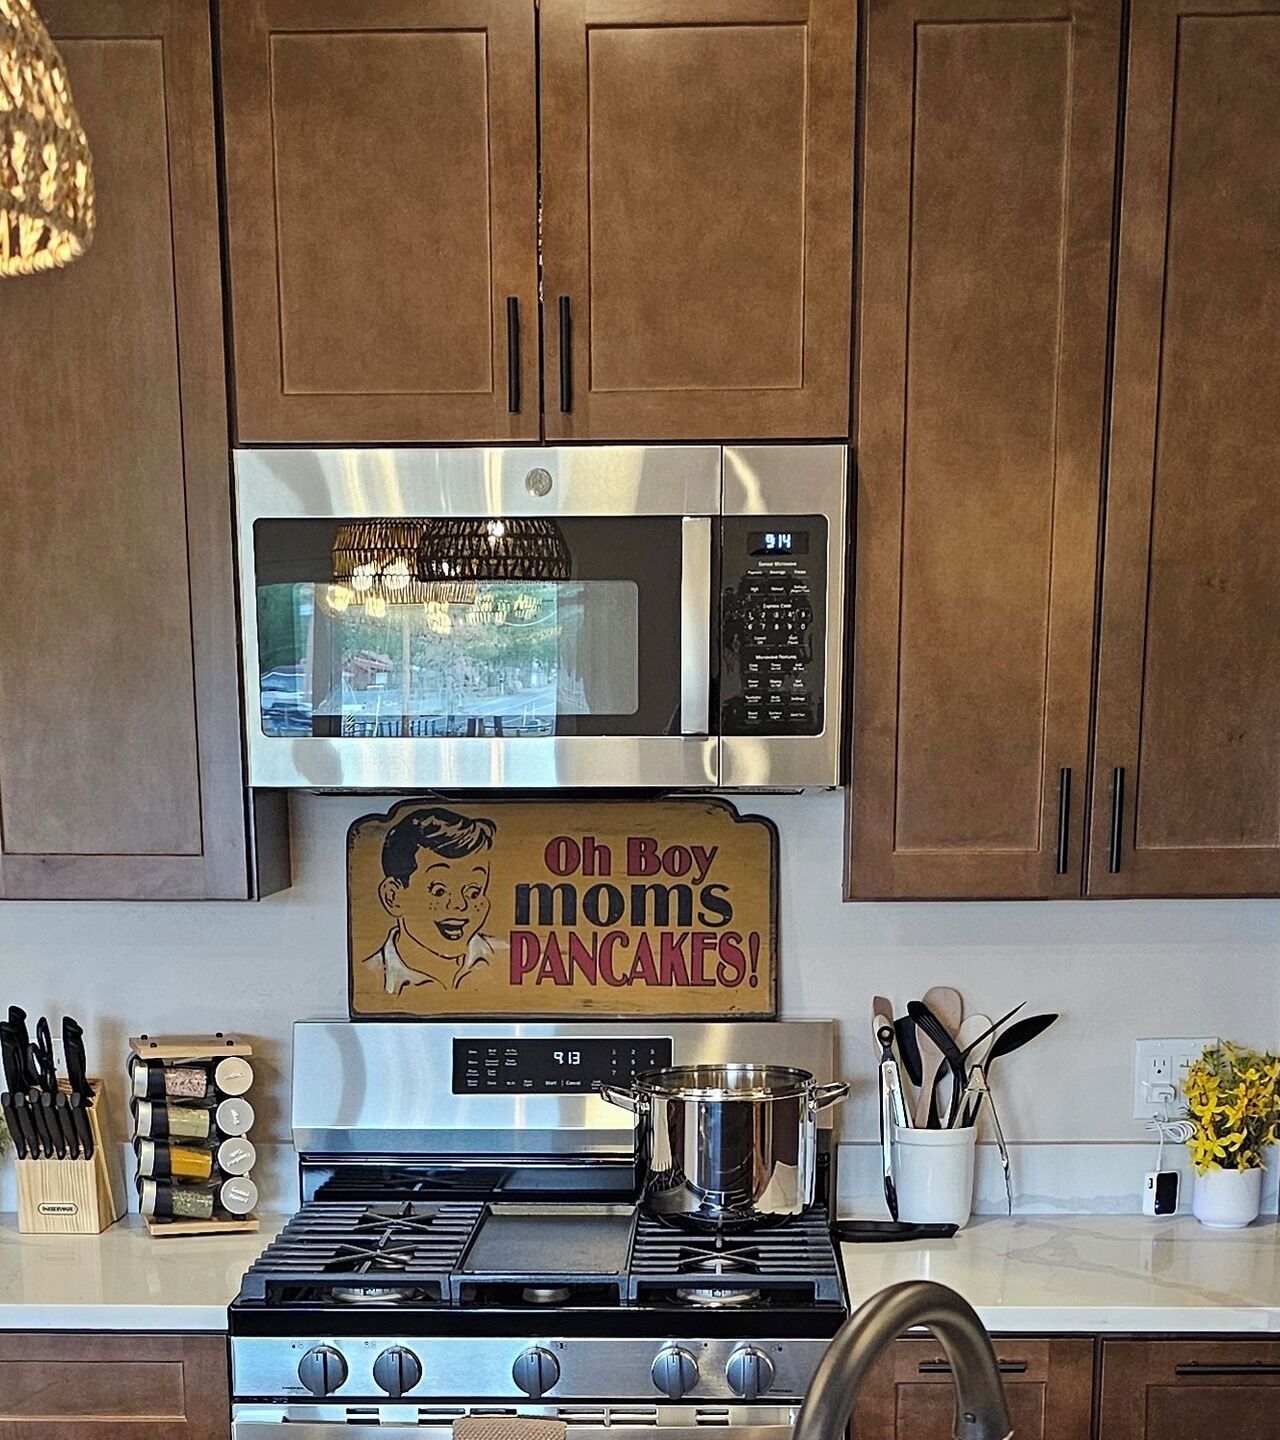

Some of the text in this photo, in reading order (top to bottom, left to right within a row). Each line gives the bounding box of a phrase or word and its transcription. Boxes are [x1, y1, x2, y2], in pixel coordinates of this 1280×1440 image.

[544, 836, 718, 885] Oh Boy
[514, 883, 733, 927] moms
[509, 930, 761, 988] PANCAKES!
